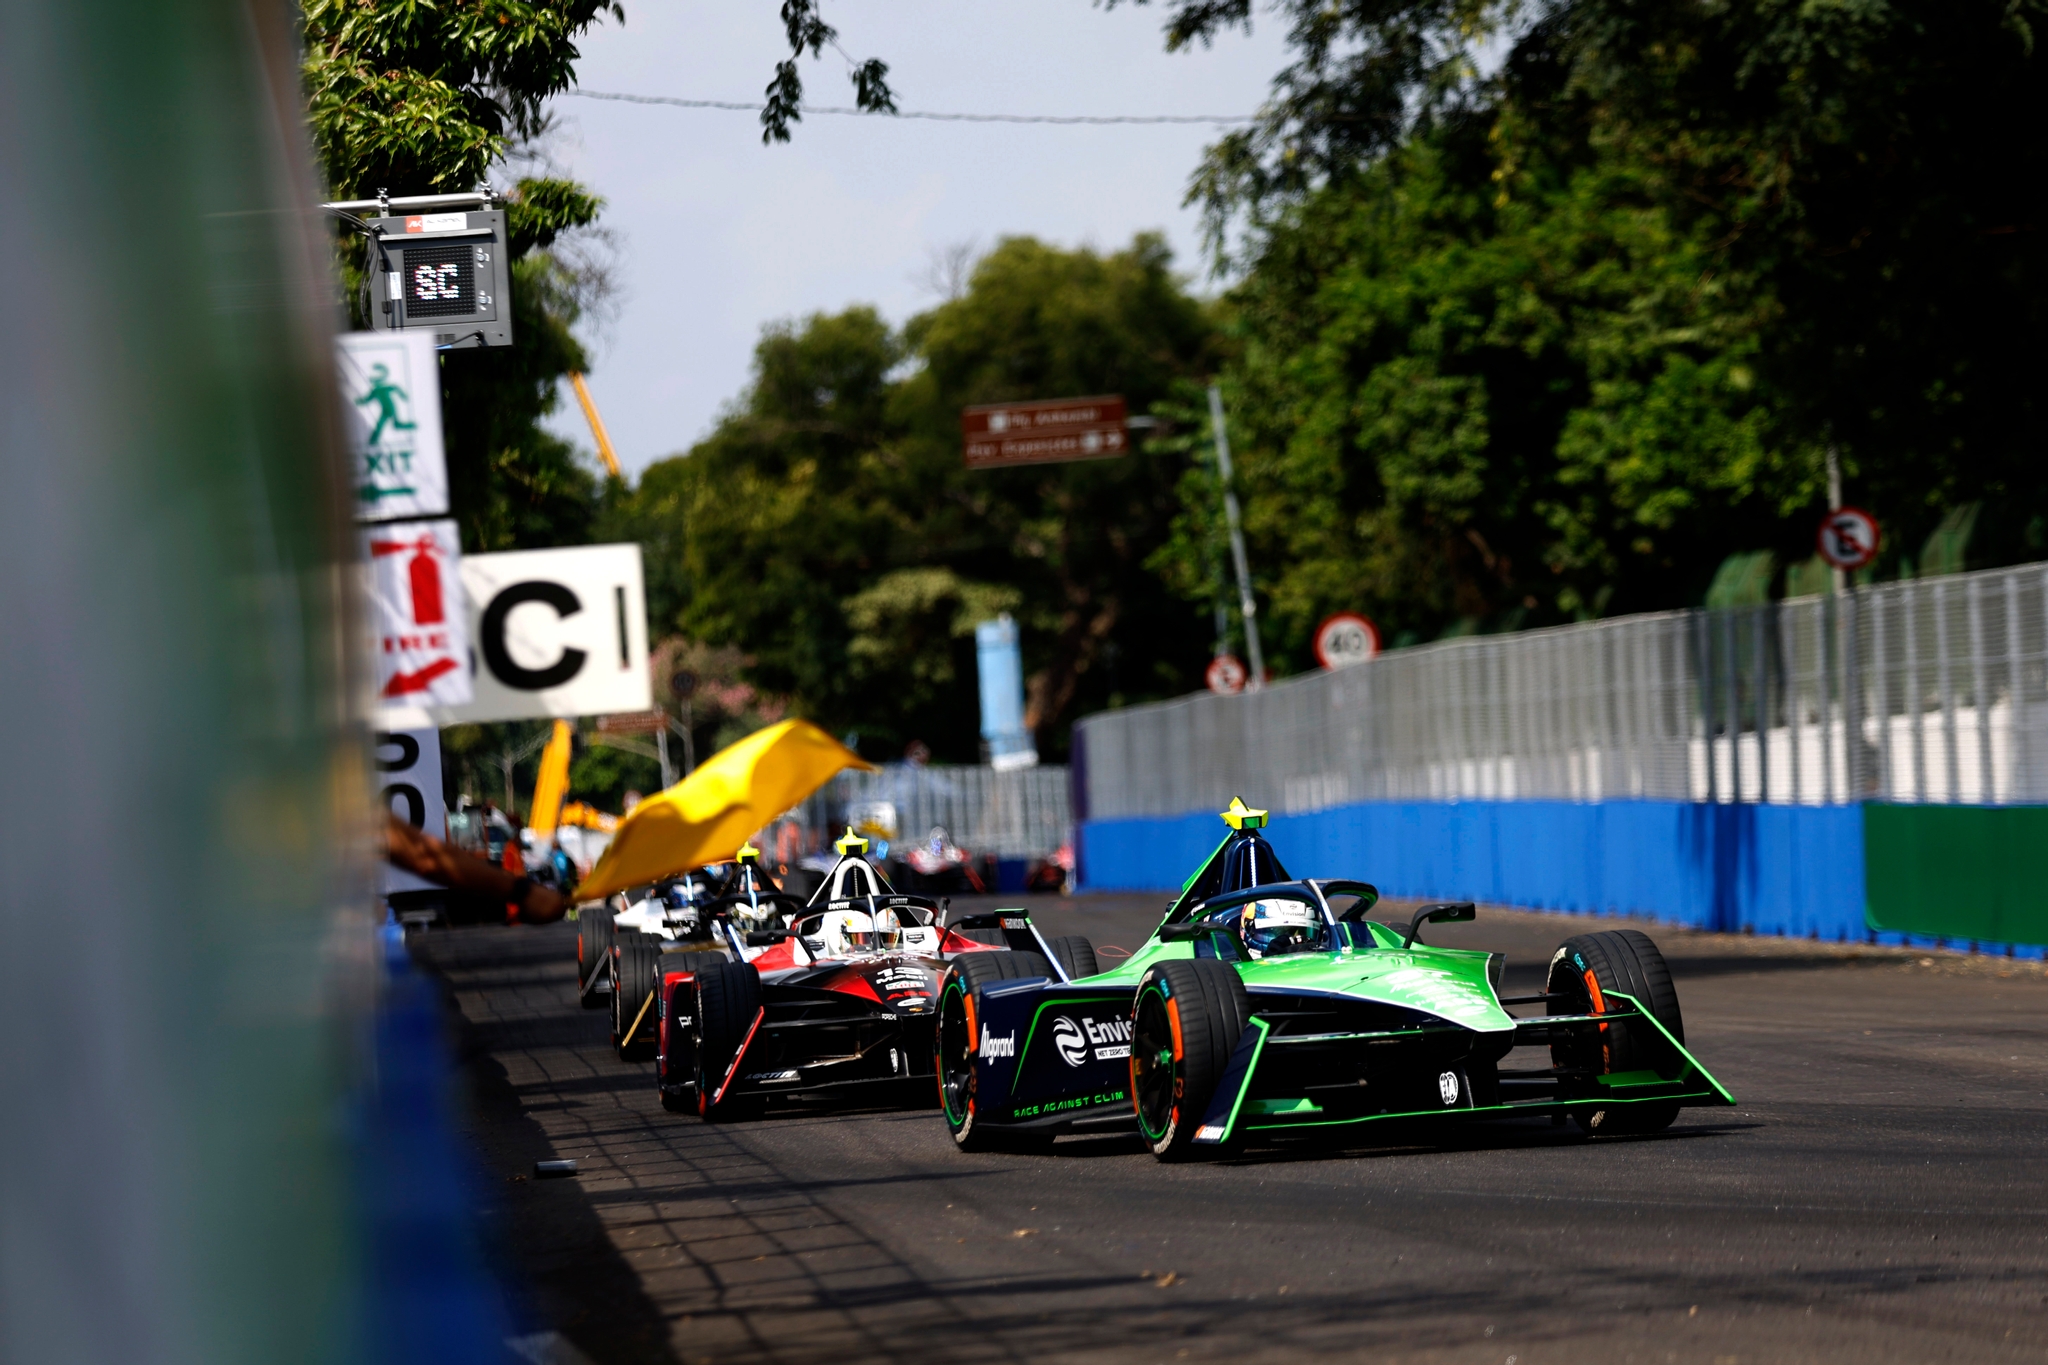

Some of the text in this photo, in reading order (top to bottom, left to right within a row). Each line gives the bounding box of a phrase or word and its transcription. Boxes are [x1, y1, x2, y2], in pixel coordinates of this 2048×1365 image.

[414, 263, 459, 299] SC
[362, 451, 412, 474] XIT
[382, 633, 447, 654] IRE
[468, 580, 588, 690] C
[979, 1022, 1014, 1065] Algorand
[1014, 1091, 1124, 1117] RACE AGAINST CLIM
